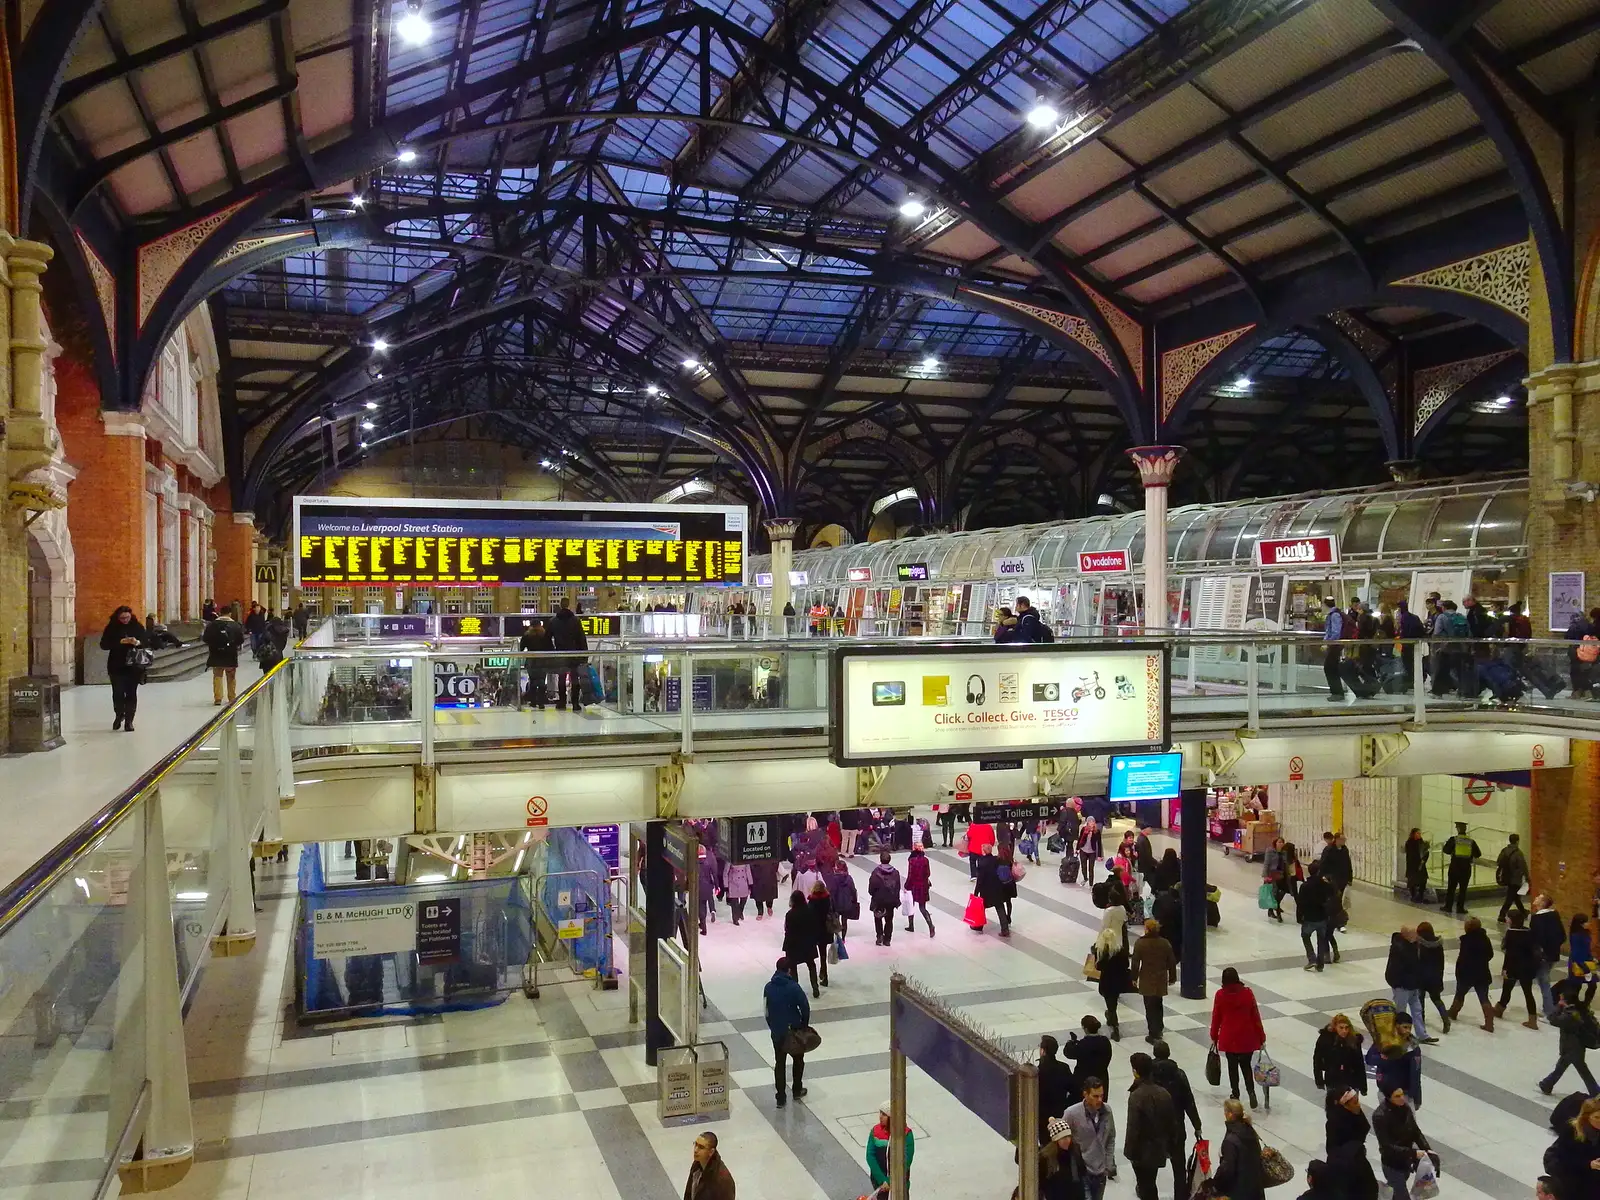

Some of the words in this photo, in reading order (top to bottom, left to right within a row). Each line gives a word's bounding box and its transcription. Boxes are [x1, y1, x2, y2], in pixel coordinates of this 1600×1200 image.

[317, 523, 351, 532] Welcome
[352, 524, 360, 532] to
[361, 523, 402, 534] Liverpool
[403, 524, 430, 533] Street
[431, 524, 464, 533] Station
[1092, 555, 1122, 567] vodafone
[934, 713, 965, 725] Click.
[967, 711, 1008, 723] Collect.
[1010, 710, 1037, 721] Give.
[1043, 707, 1079, 718] TESCO
[985, 762, 1018, 770] JCDecaux
[1005, 809, 1034, 818] Toilets
[346, 909, 384, 918] McHUGH
[386, 907, 402, 915] LTD
[668, 1090, 690, 1100] METRO
[703, 1086, 724, 1095] METRO
